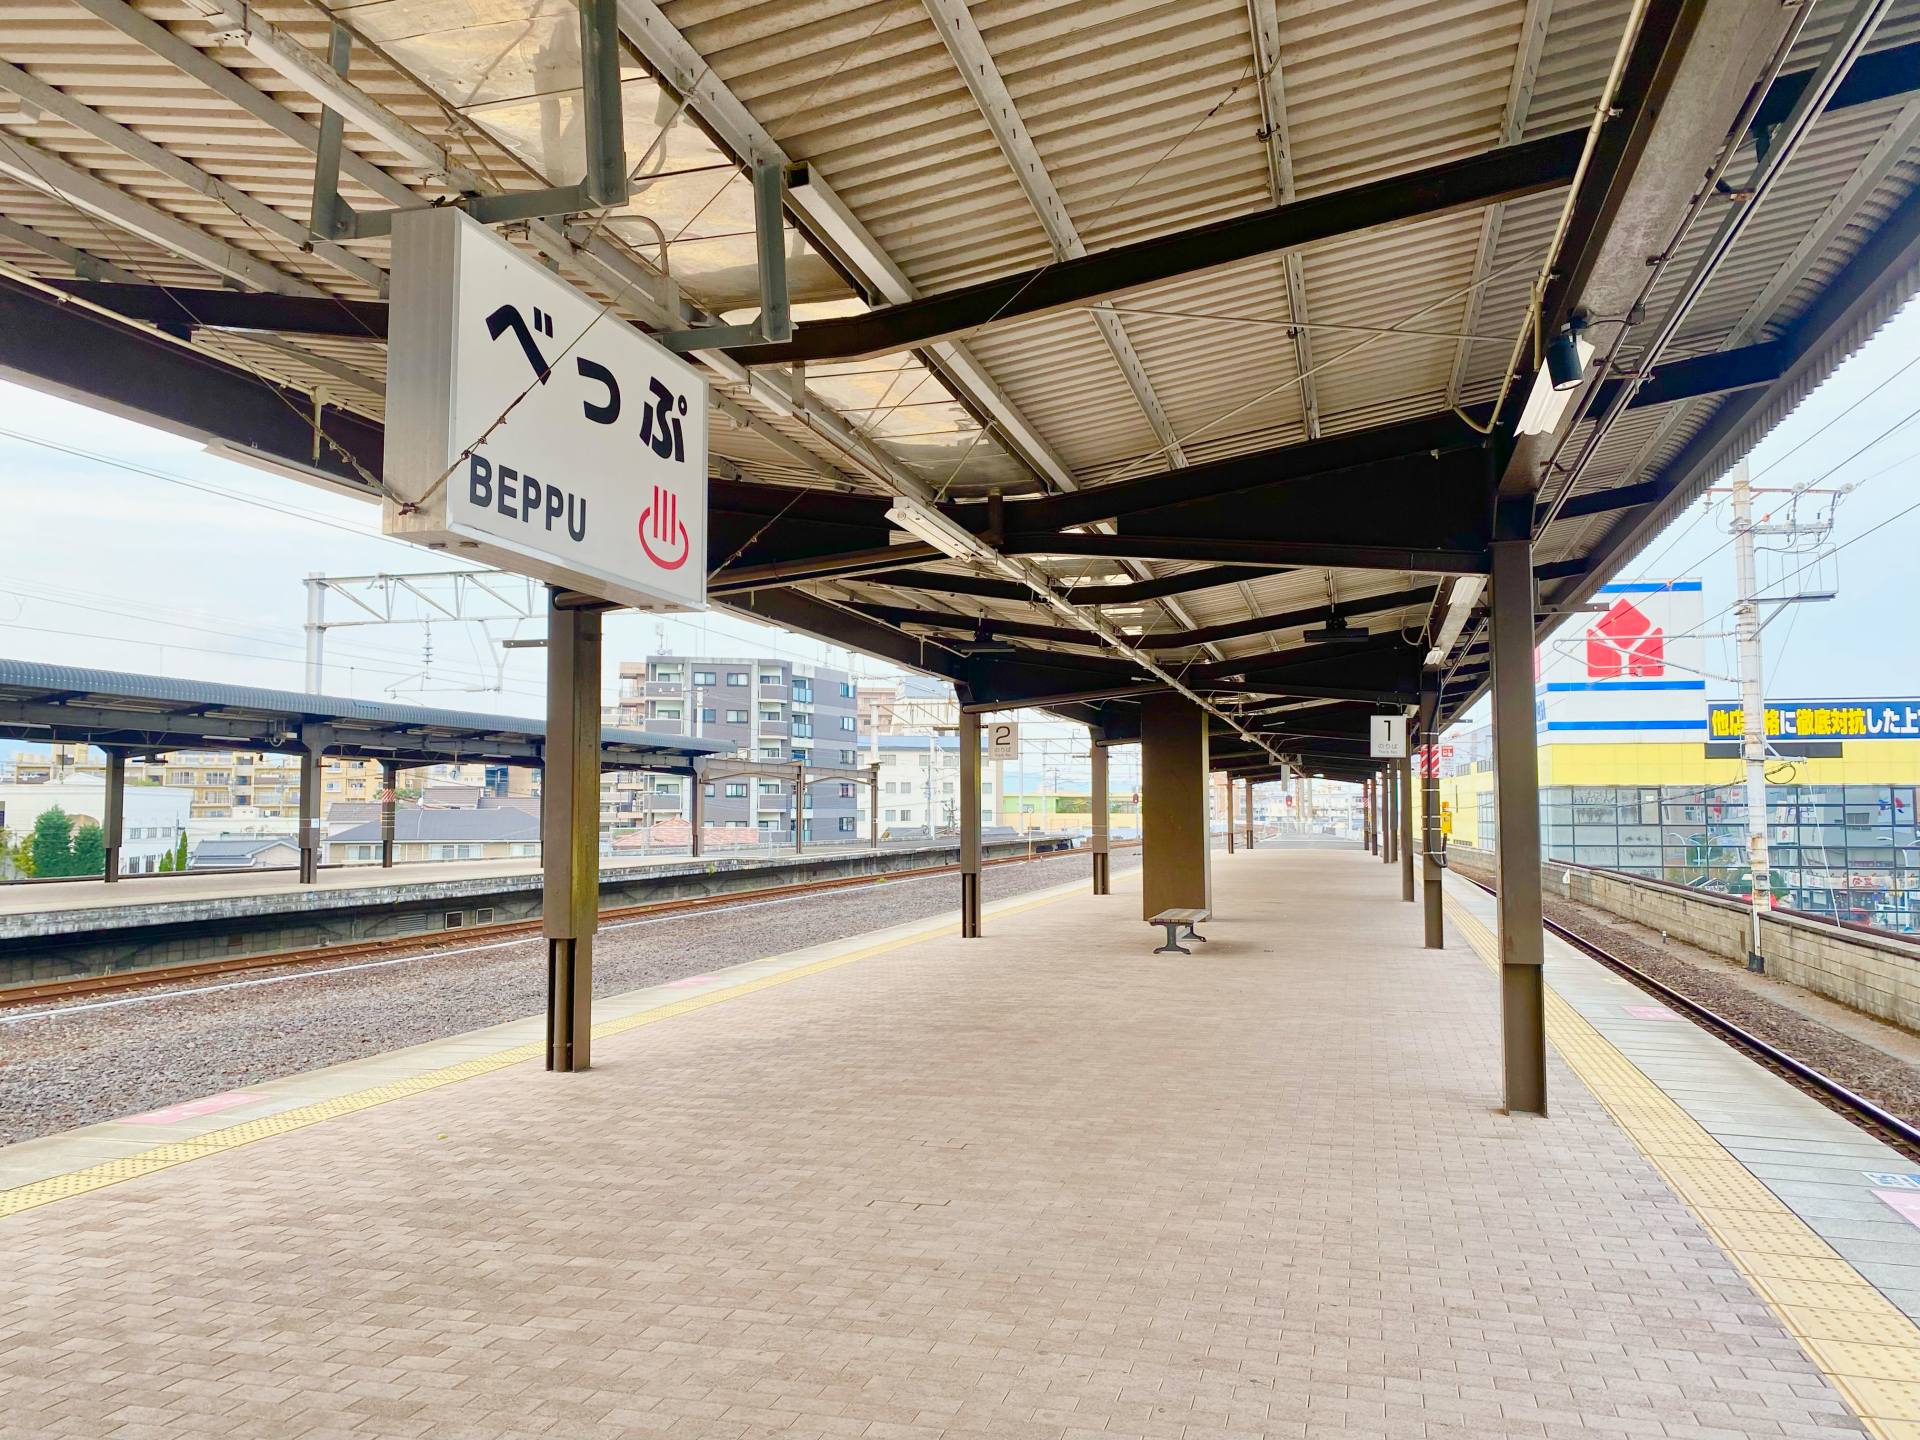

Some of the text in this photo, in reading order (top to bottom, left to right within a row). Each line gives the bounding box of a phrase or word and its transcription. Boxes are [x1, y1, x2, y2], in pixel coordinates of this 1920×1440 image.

[485, 304, 688, 463] べっぷ
[469, 453, 587, 542] BEPPU
[1383, 720, 1391, 741] 1
[1711, 707, 1920, 735] 他店格に徹底対抗した上
[996, 726, 1011, 745] 2
